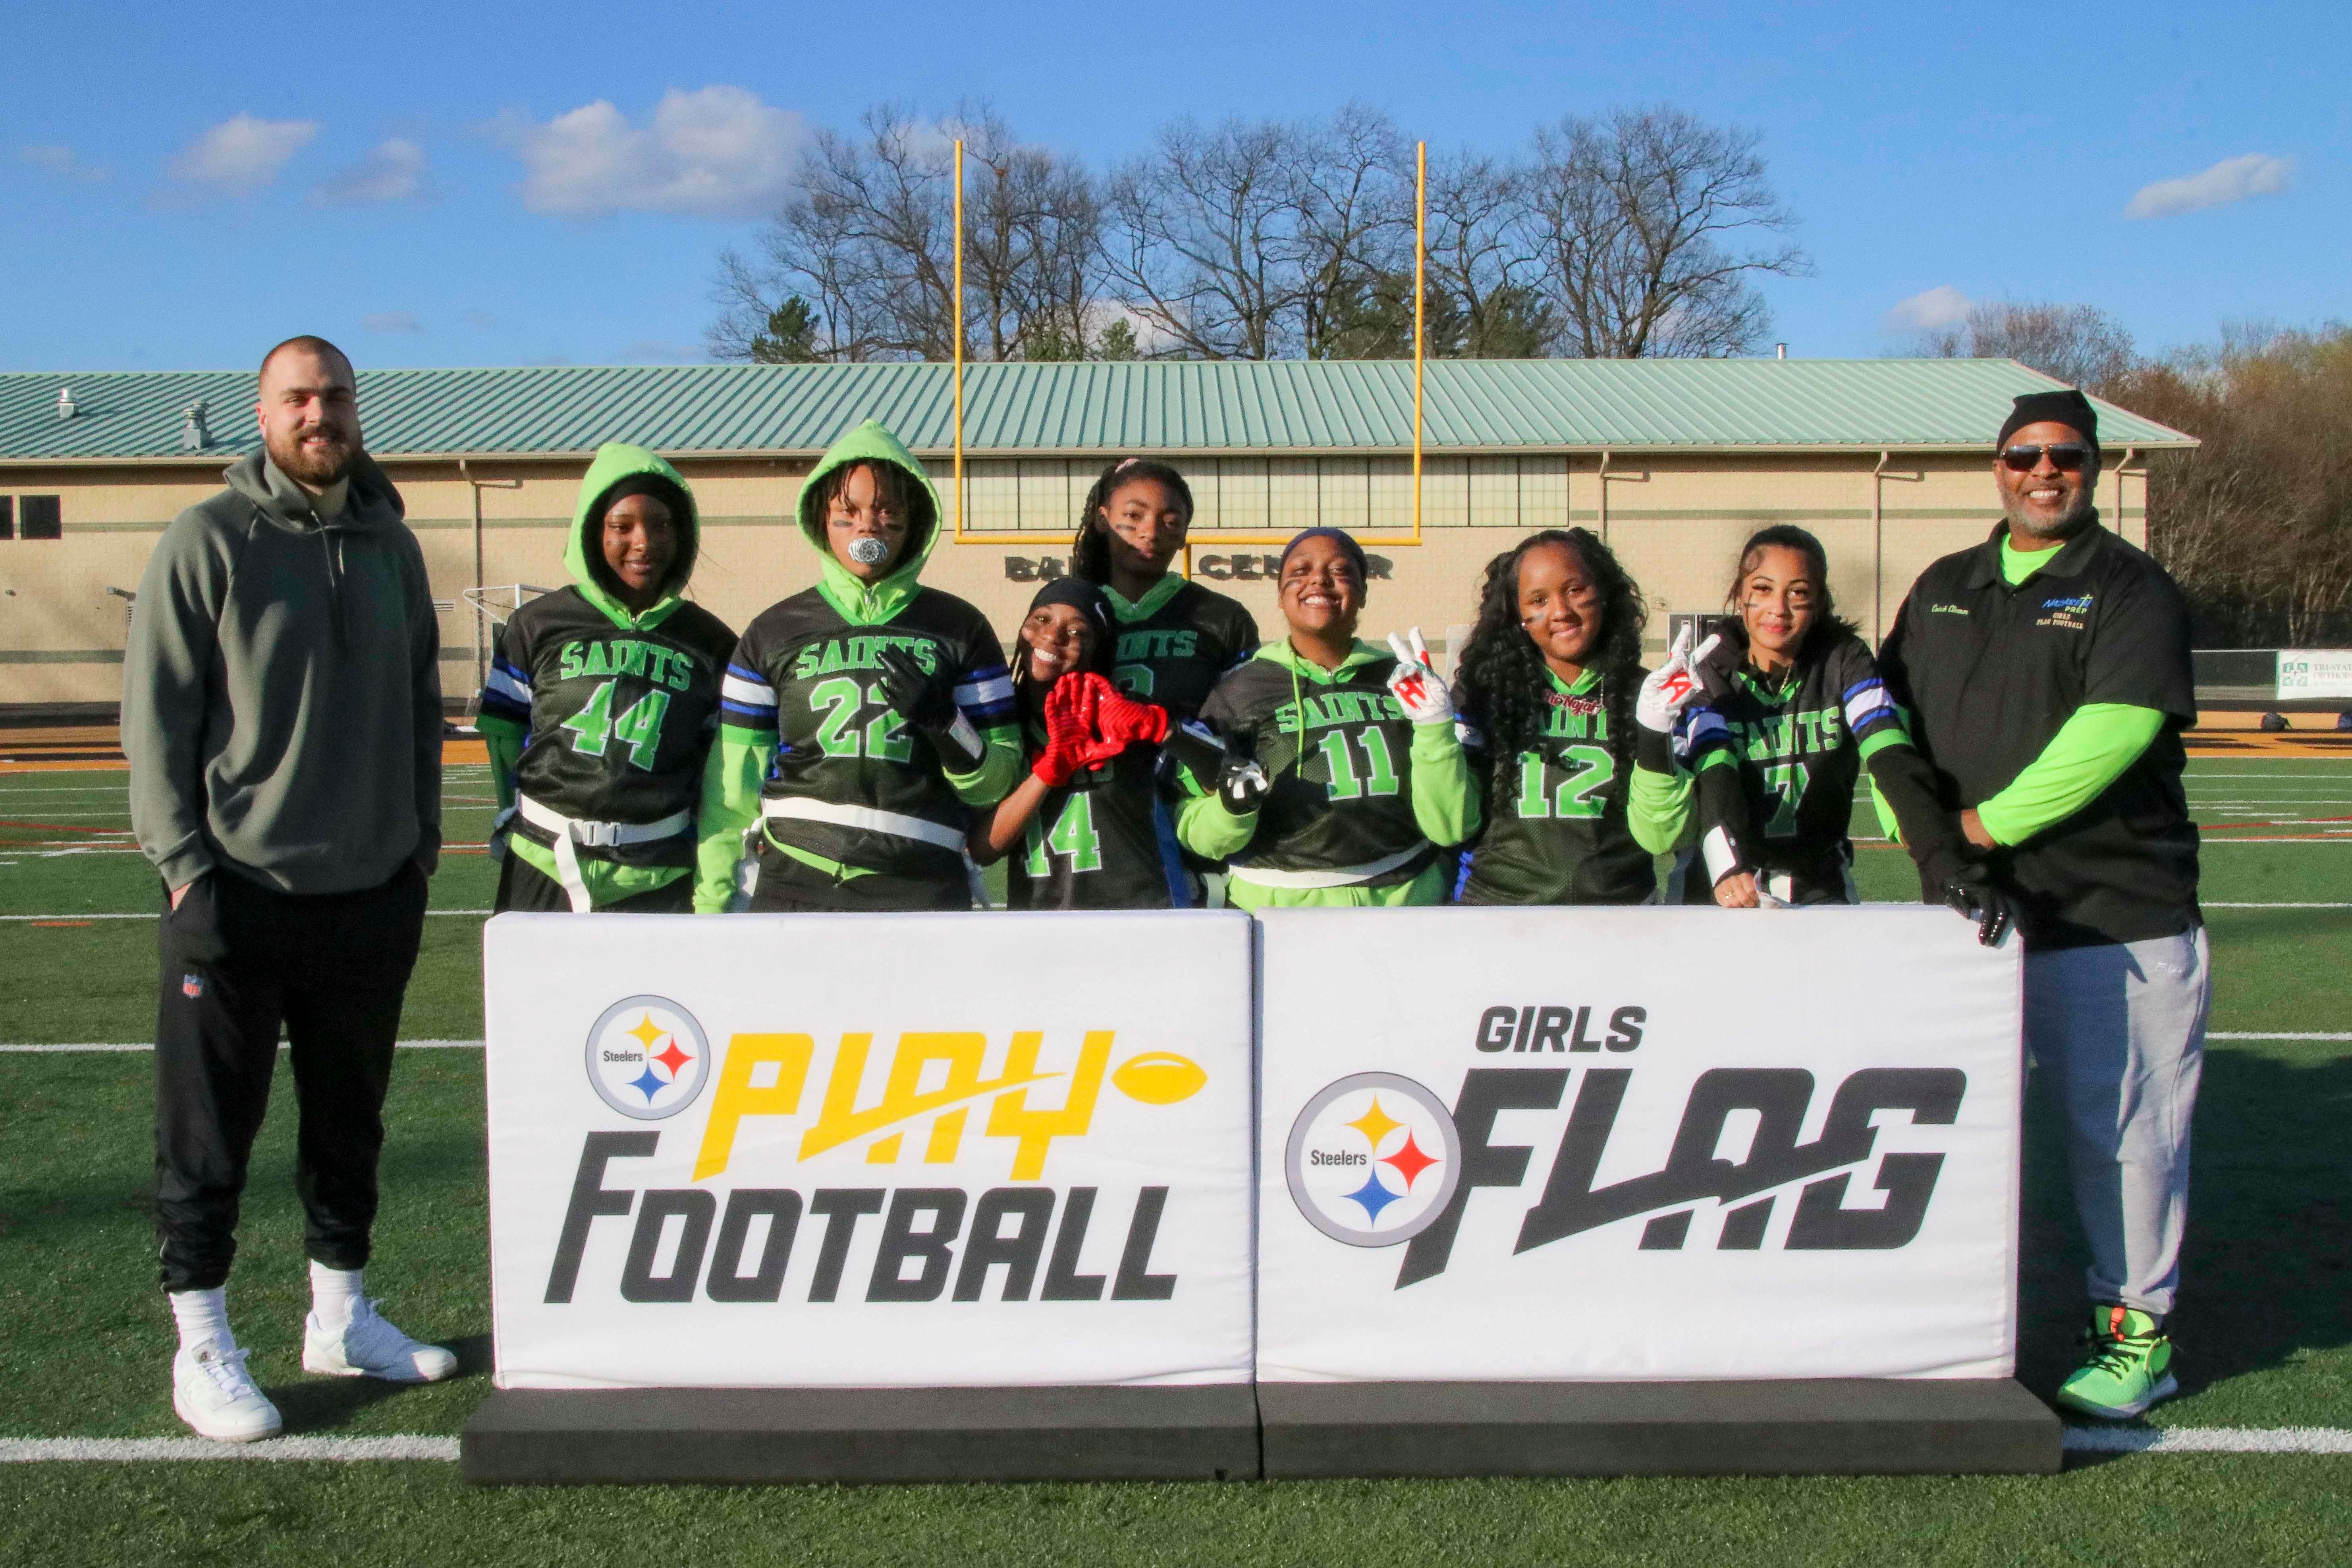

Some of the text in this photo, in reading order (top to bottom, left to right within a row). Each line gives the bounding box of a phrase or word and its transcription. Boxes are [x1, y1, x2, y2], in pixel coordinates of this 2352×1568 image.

[2065, 606, 2088, 614] PREP
[560, 639, 694, 691] SAINTS
[560, 677, 671, 772] 44
[809, 676, 914, 764] 22
[1275, 691, 1412, 733] SAINTS
[1318, 725, 1399, 801] 11
[1516, 744, 1615, 819] 12
[1764, 762, 1810, 839] 7
[1025, 791, 1102, 877] 14
[603, 1050, 643, 1062] Steelers
[1475, 1005, 1646, 1053] GIRLS
[691, 1030, 1116, 1182] PLAY
[1310, 1149, 1367, 1165] Steelers
[1394, 1068, 1967, 1291] FLAG
[543, 1130, 1178, 1303] FOOTBALL
